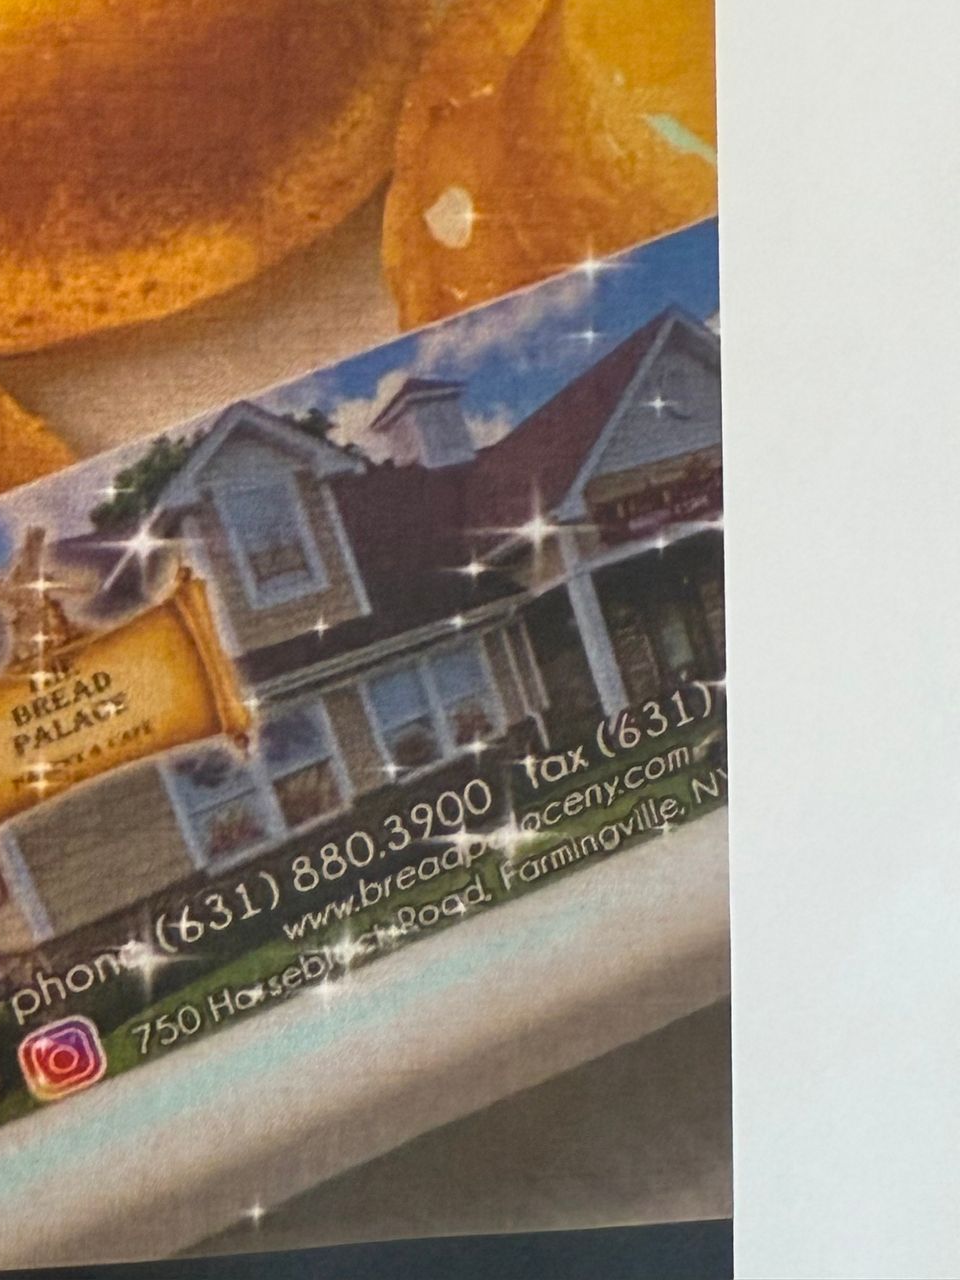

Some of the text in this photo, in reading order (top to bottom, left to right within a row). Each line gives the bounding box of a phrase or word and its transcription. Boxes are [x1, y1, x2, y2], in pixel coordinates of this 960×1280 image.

[11, 671, 111, 727] BREAD
[155, 871, 280, 953] (631)
[291, 778, 492, 892] 880.3900
[596, 681, 712, 758] (631)
[132, 1005, 201, 1054] 750
